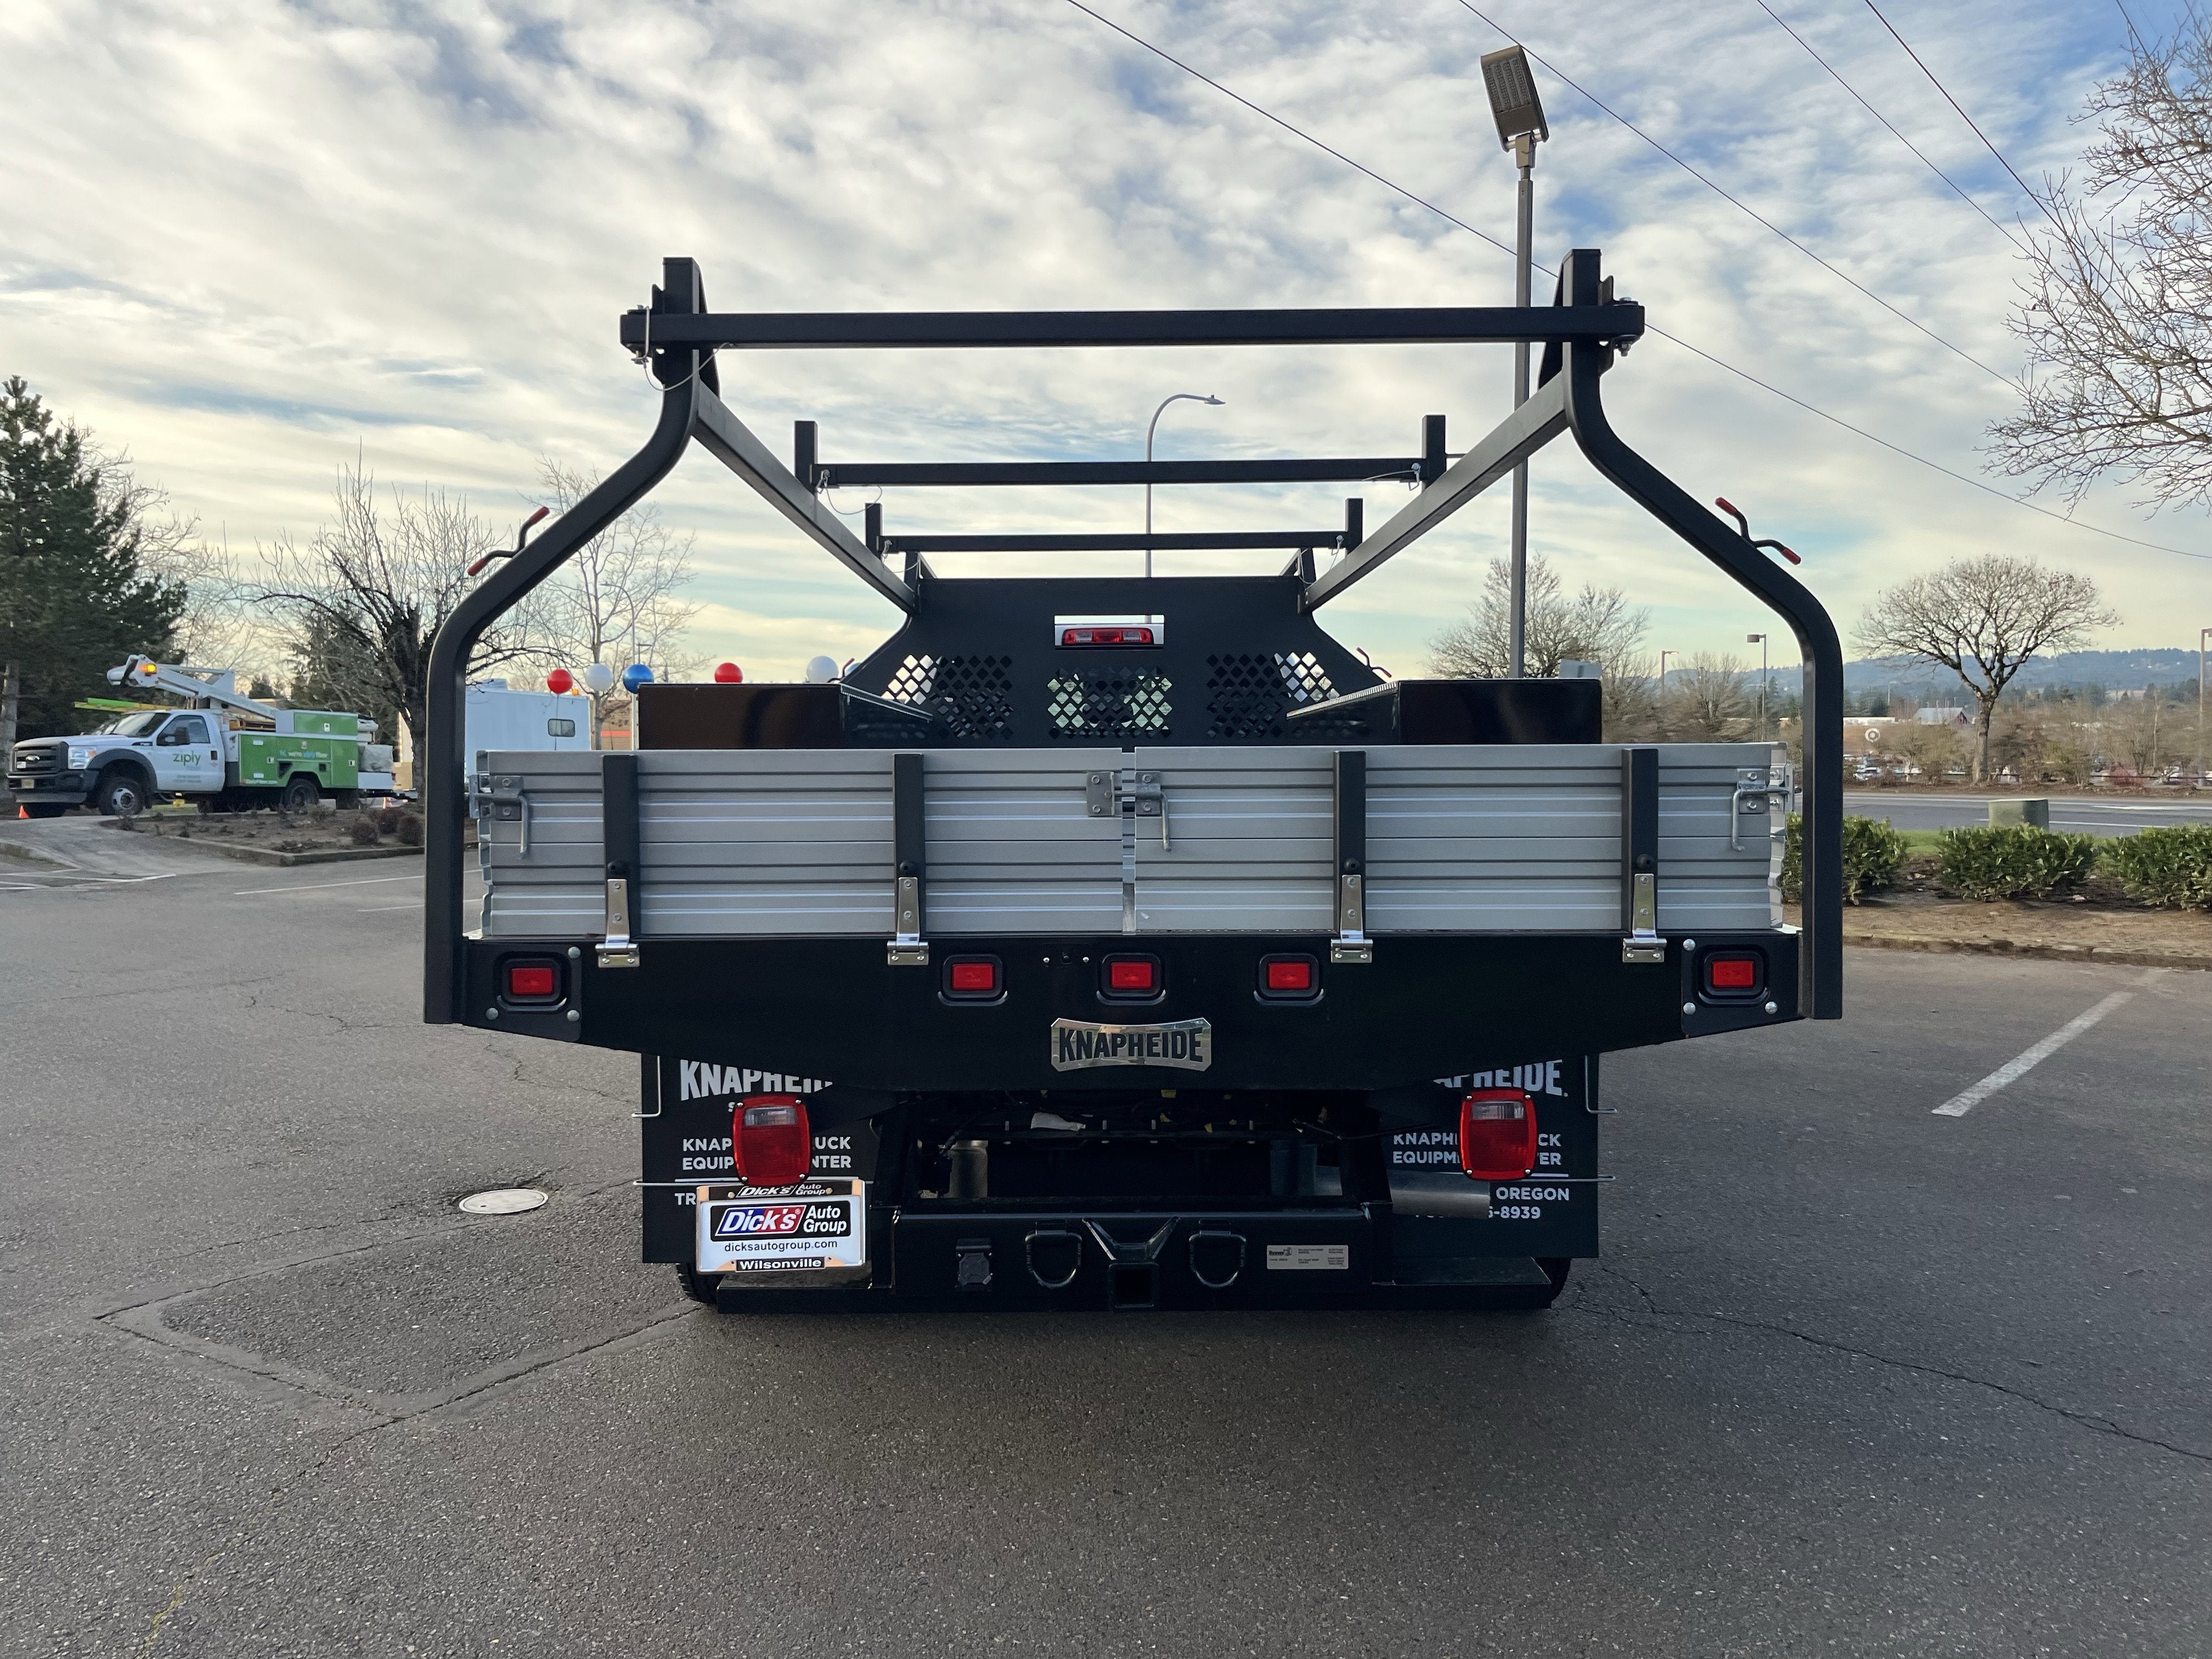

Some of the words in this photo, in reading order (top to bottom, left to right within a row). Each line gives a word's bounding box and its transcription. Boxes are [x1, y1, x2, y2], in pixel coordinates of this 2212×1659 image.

[173, 751, 201, 766] ziply
[1059, 1026, 1203, 1063] KNAPHEIDE
[814, 1136, 851, 1150] UCK
[1393, 1132, 1458, 1146] KNAPH
[682, 1156, 734, 1170] EQUIP
[811, 1155, 851, 1168] NTER
[1393, 1151, 1461, 1164] EQUIPM
[1496, 1187, 1570, 1201] OREGON
[805, 1205, 840, 1218] Auto
[722, 1209, 796, 1232] Dick's
[804, 1220, 847, 1234] Group
[725, 1240, 837, 1252] dicksautogroup.com
[740, 1259, 821, 1270] Wilsonville
